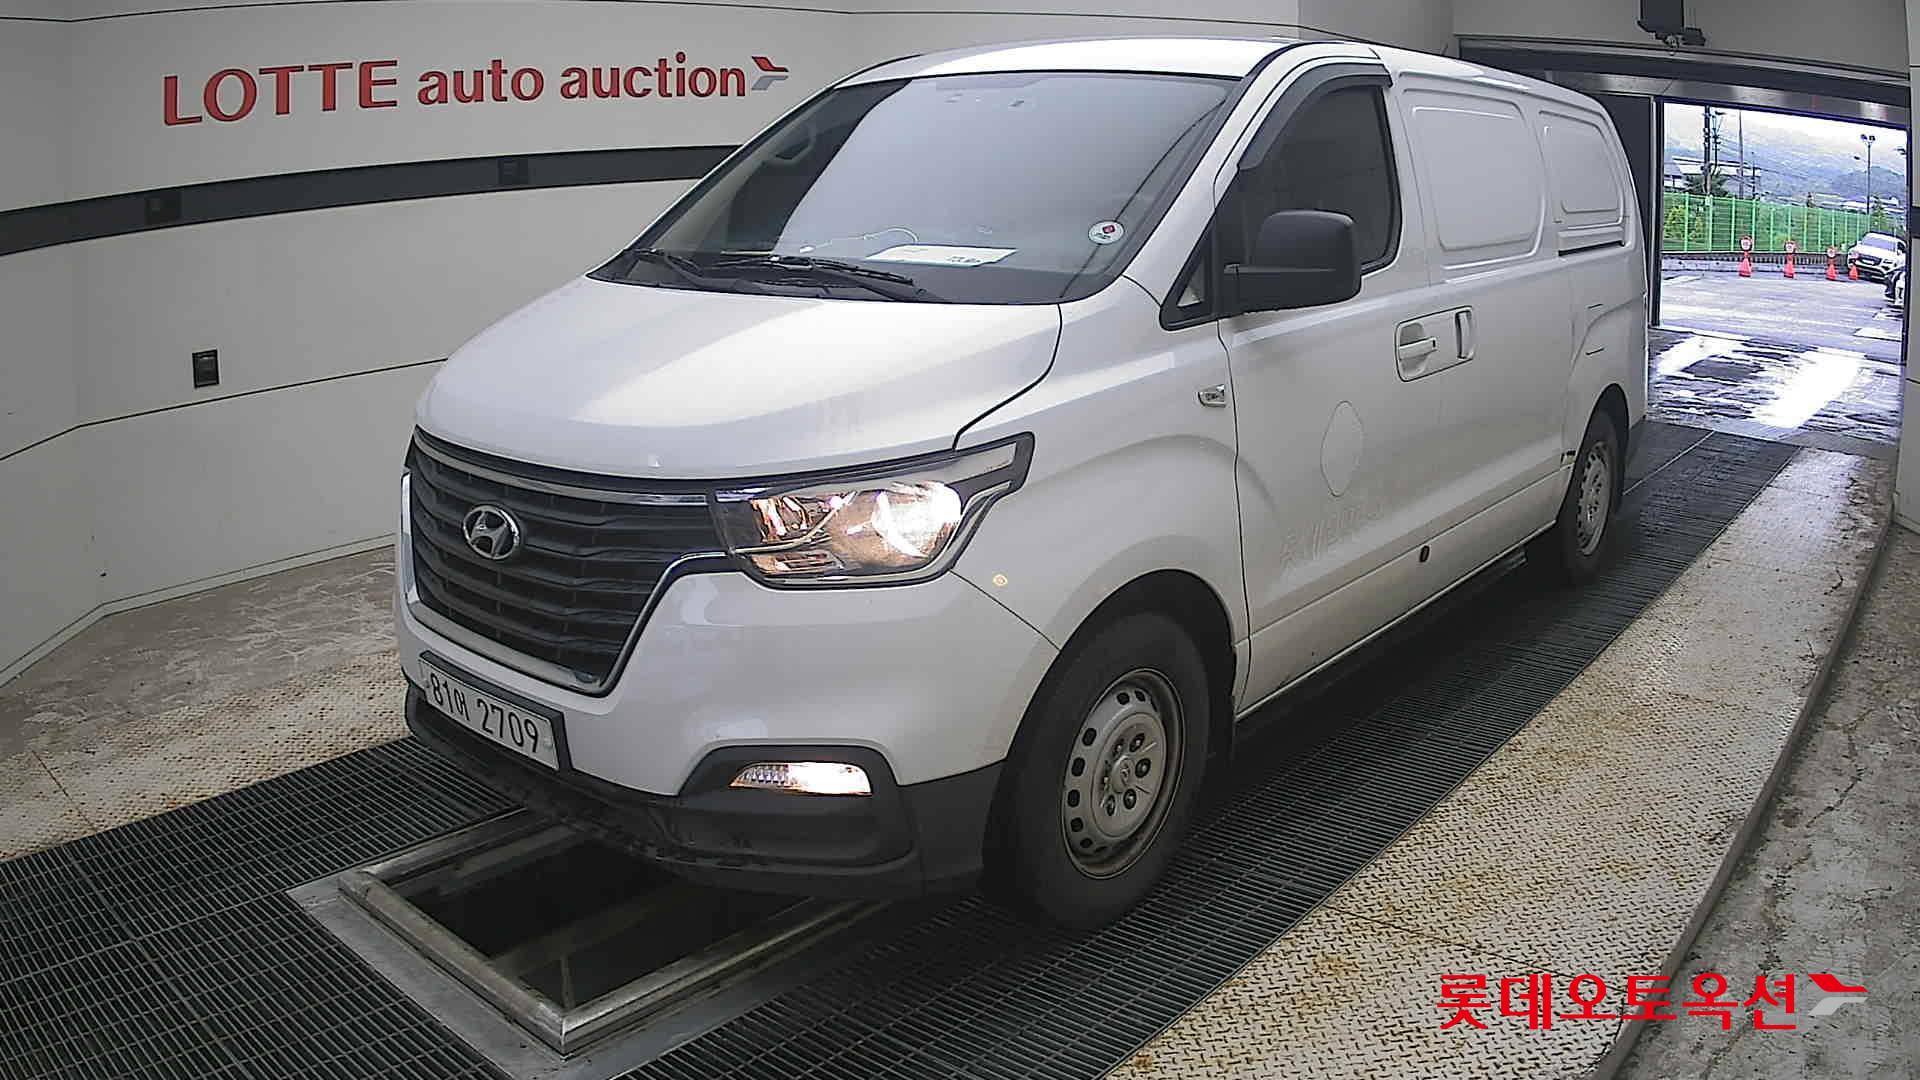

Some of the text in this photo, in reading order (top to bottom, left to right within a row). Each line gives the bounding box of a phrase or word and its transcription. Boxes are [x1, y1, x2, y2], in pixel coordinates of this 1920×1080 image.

[163, 51, 747, 126] LOTTE auto auction
[430, 672, 539, 753] 81어 2709
